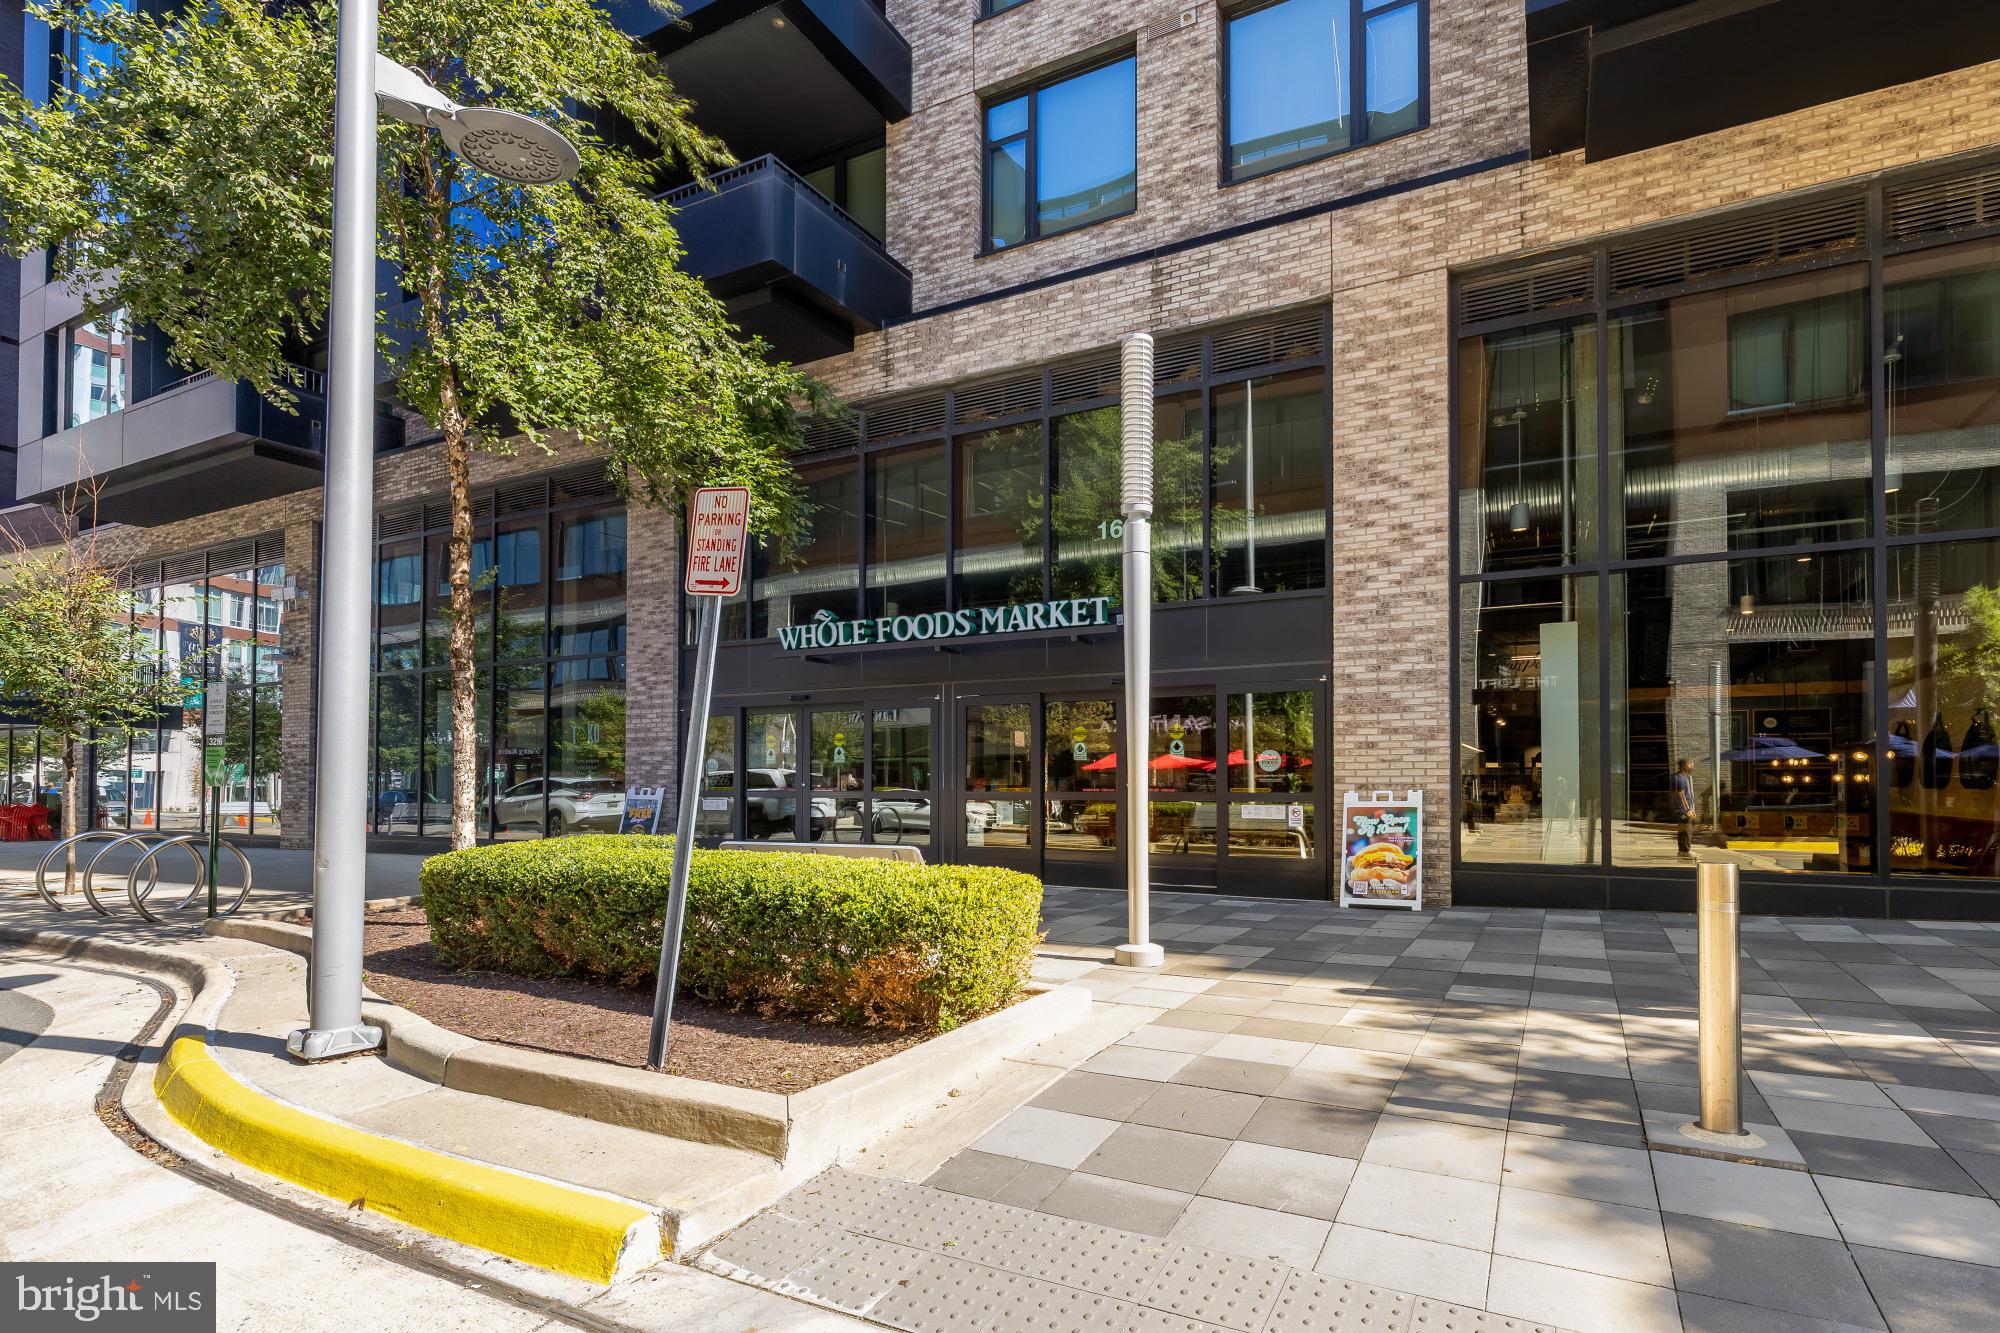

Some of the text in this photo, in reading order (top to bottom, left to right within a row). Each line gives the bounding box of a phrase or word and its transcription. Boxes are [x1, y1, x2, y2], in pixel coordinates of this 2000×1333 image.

[714, 495, 728, 508] NO
[697, 512, 742, 526] PARKING
[696, 538, 737, 552] STANDING
[693, 556, 737, 573] FIRE LANE
[776, 597, 1112, 651] WHOLE FOODS MARKET
[208, 737, 223, 746] 3216
